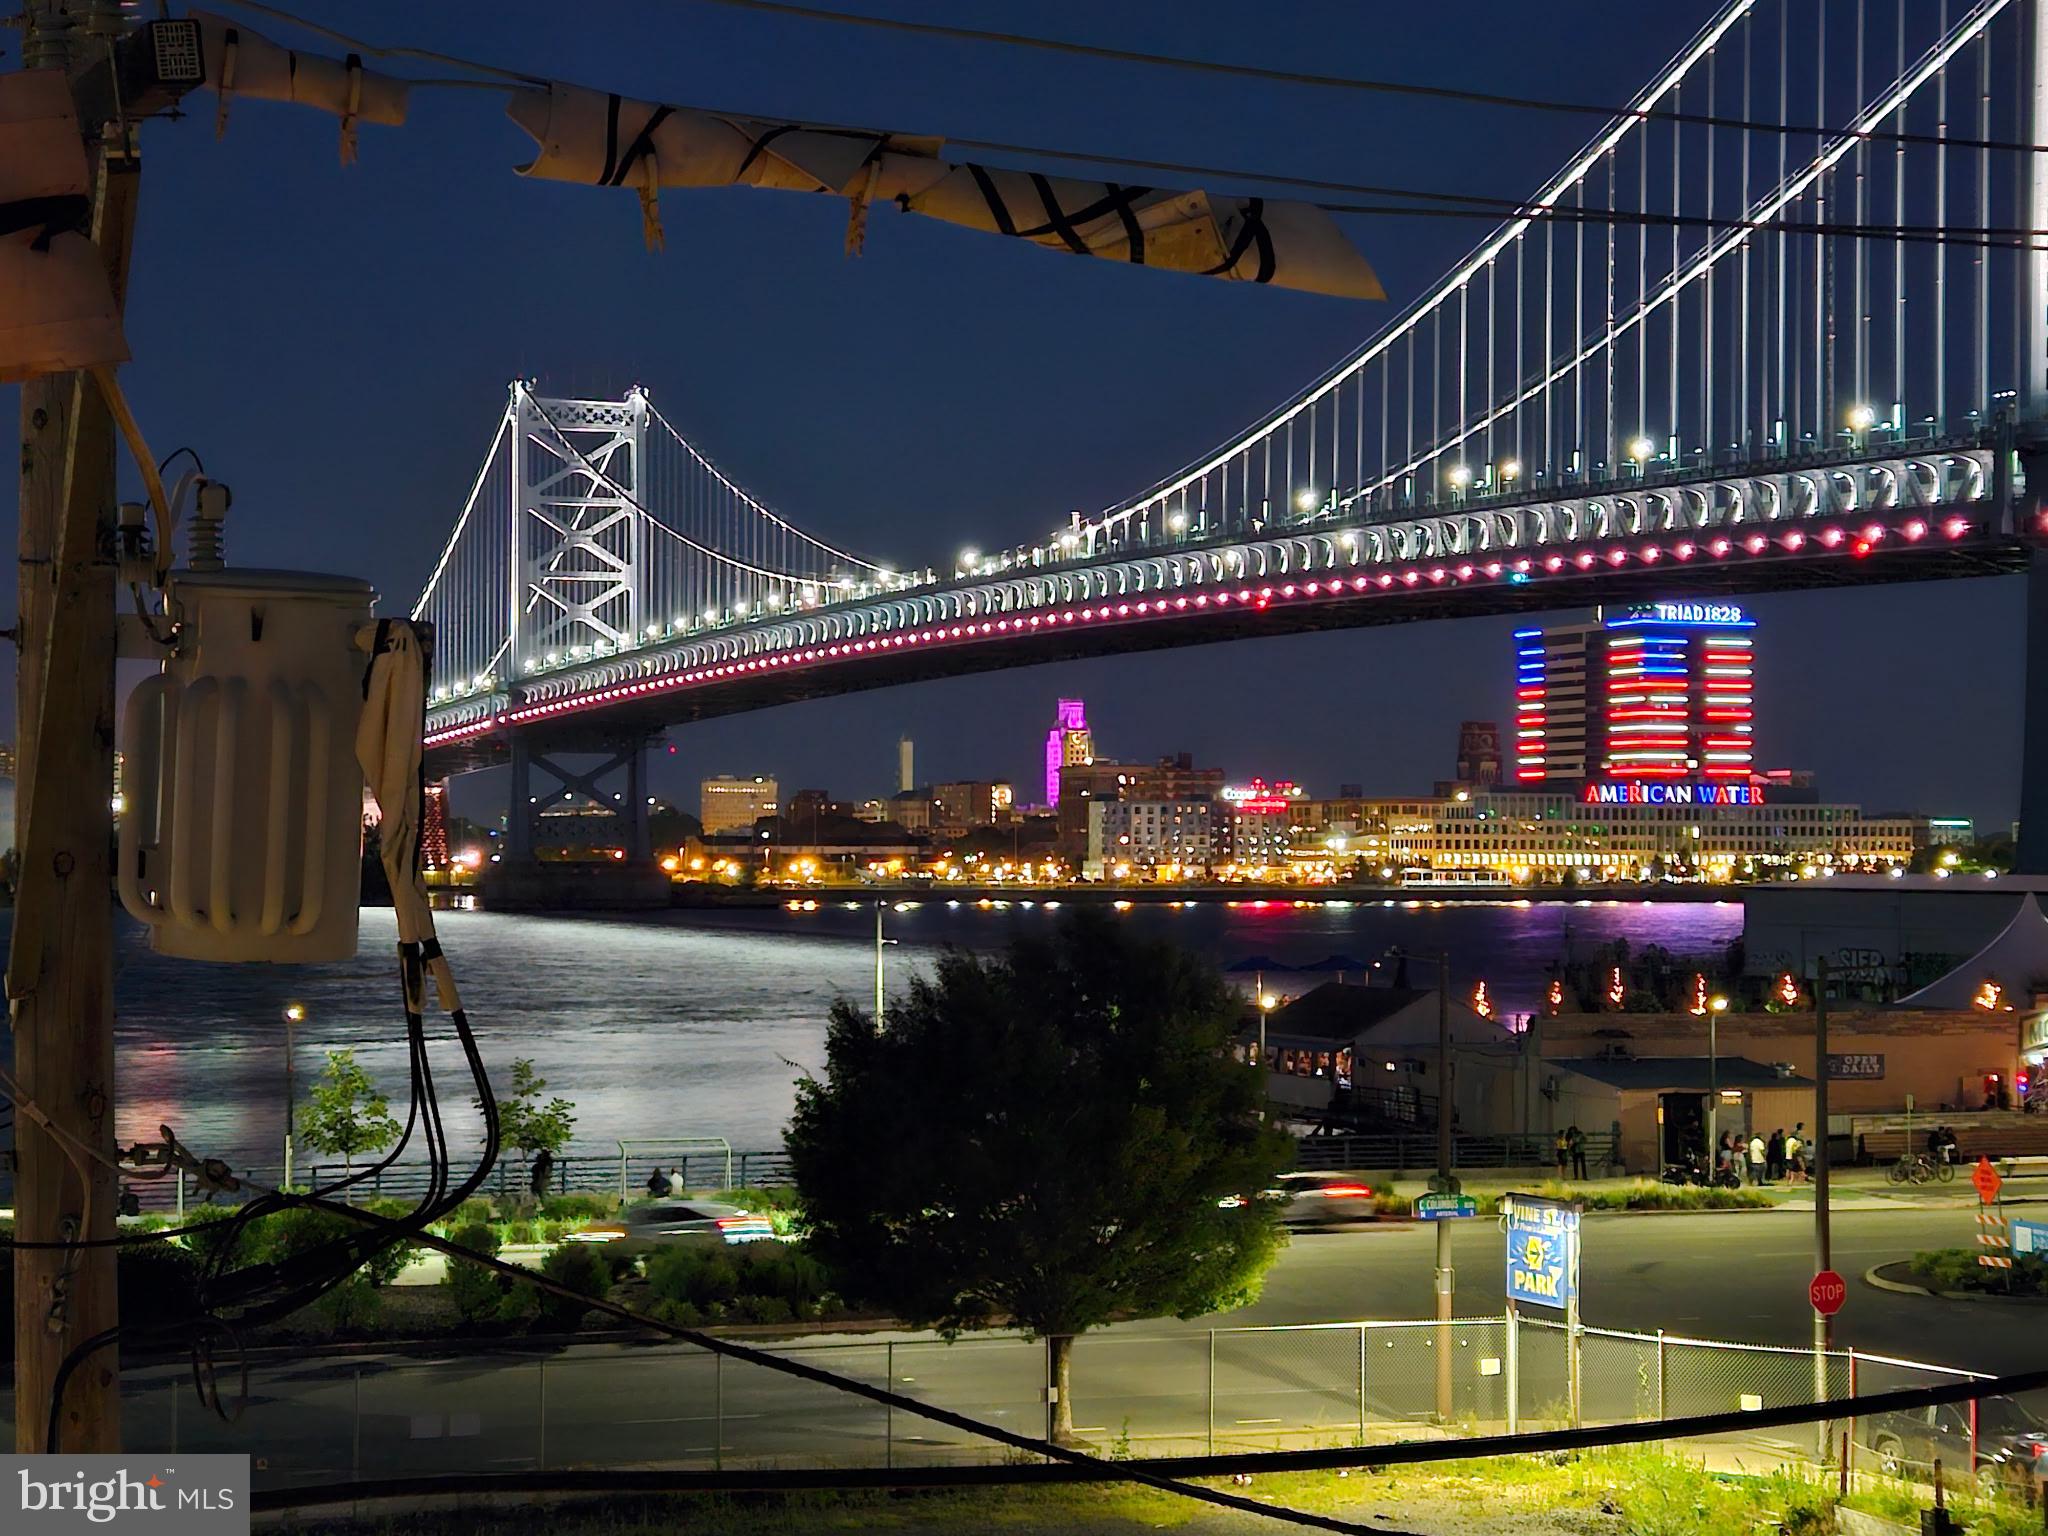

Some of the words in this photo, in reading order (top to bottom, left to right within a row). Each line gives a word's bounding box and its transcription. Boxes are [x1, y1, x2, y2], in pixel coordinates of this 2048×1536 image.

[1657, 604, 1742, 622] TRIAD1828
[1586, 784, 1692, 803] AMERICAN
[1698, 784, 1764, 804] WATER
[1841, 1064, 1880, 1073] DAILY
[1844, 1055, 1878, 1065] OPEN
[1514, 1204, 1541, 1223] VINE
[1514, 1266, 1564, 1298] PARK
[1812, 1283, 1844, 1302] STOP
